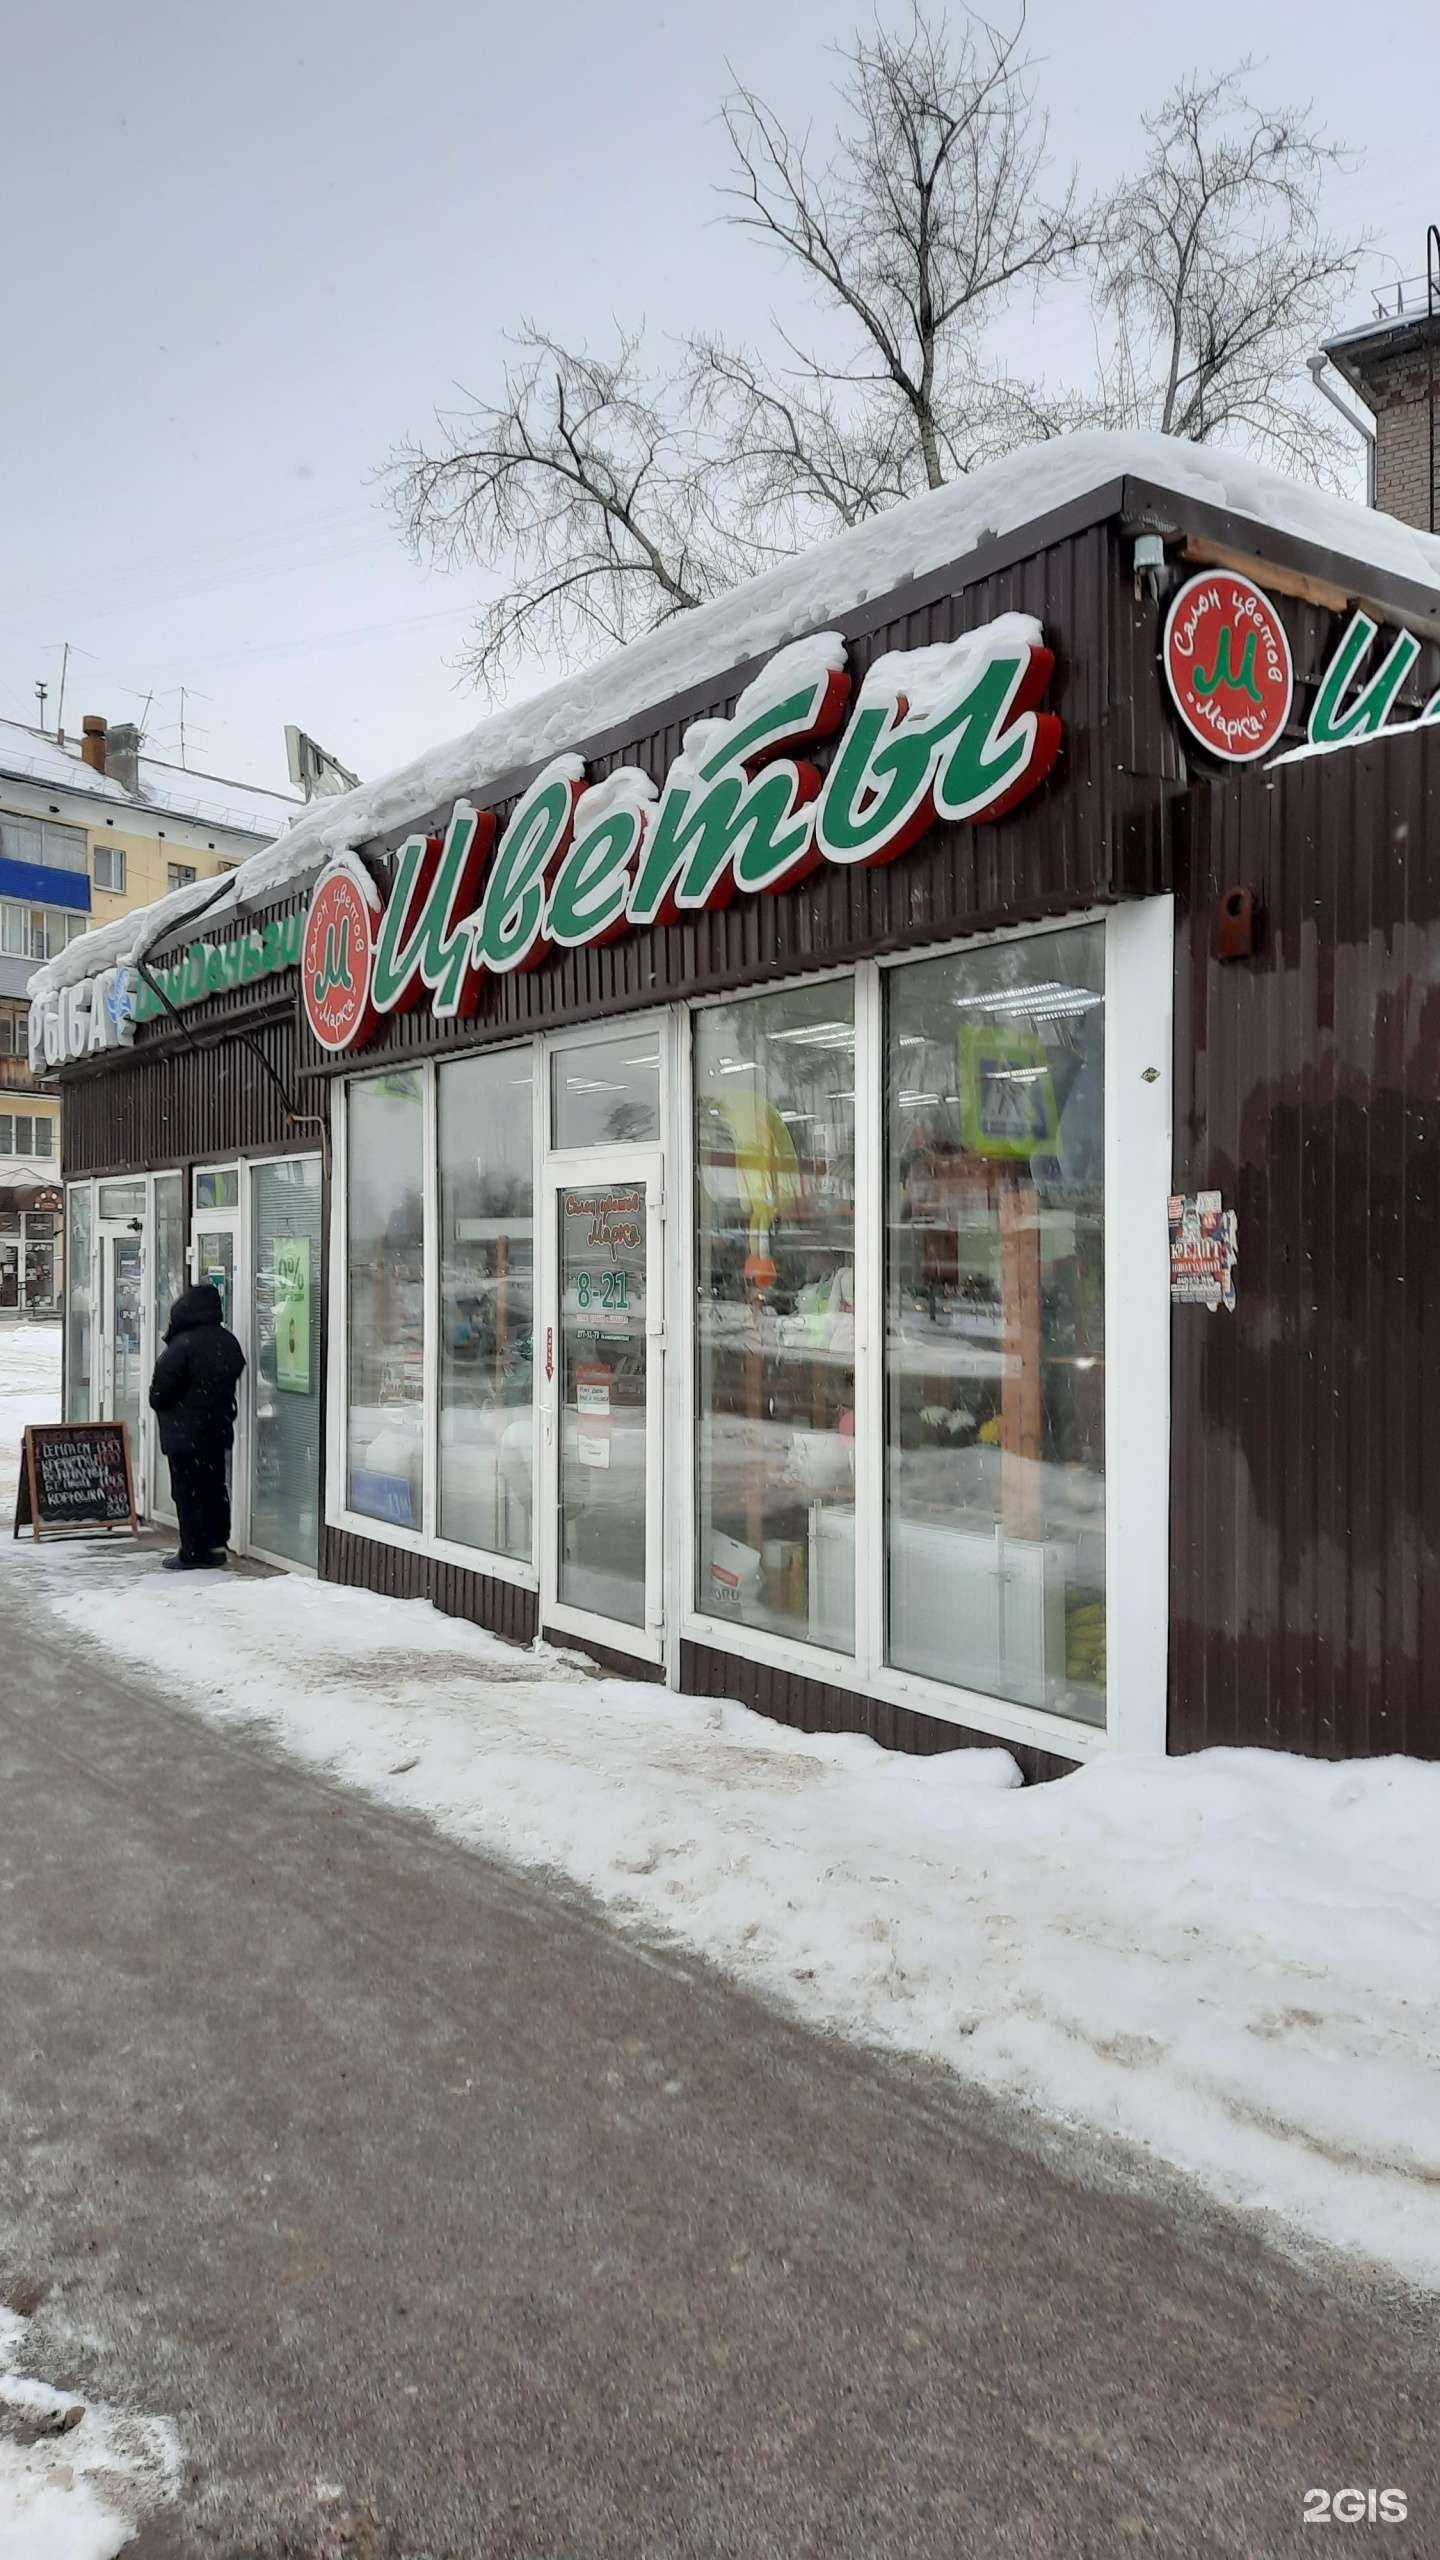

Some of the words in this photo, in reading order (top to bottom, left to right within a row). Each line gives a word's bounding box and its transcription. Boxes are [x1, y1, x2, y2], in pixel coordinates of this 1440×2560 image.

[1173, 588, 1222, 657] Салон
[1231, 590, 1283, 683] цветов
[370, 640, 1050, 1018] Цветы
[306, 900, 329, 974] Салон
[333, 883, 365, 953] цветов
[587, 1217, 641, 1262] Марка
[577, 1271, 630, 1310] 8-21
